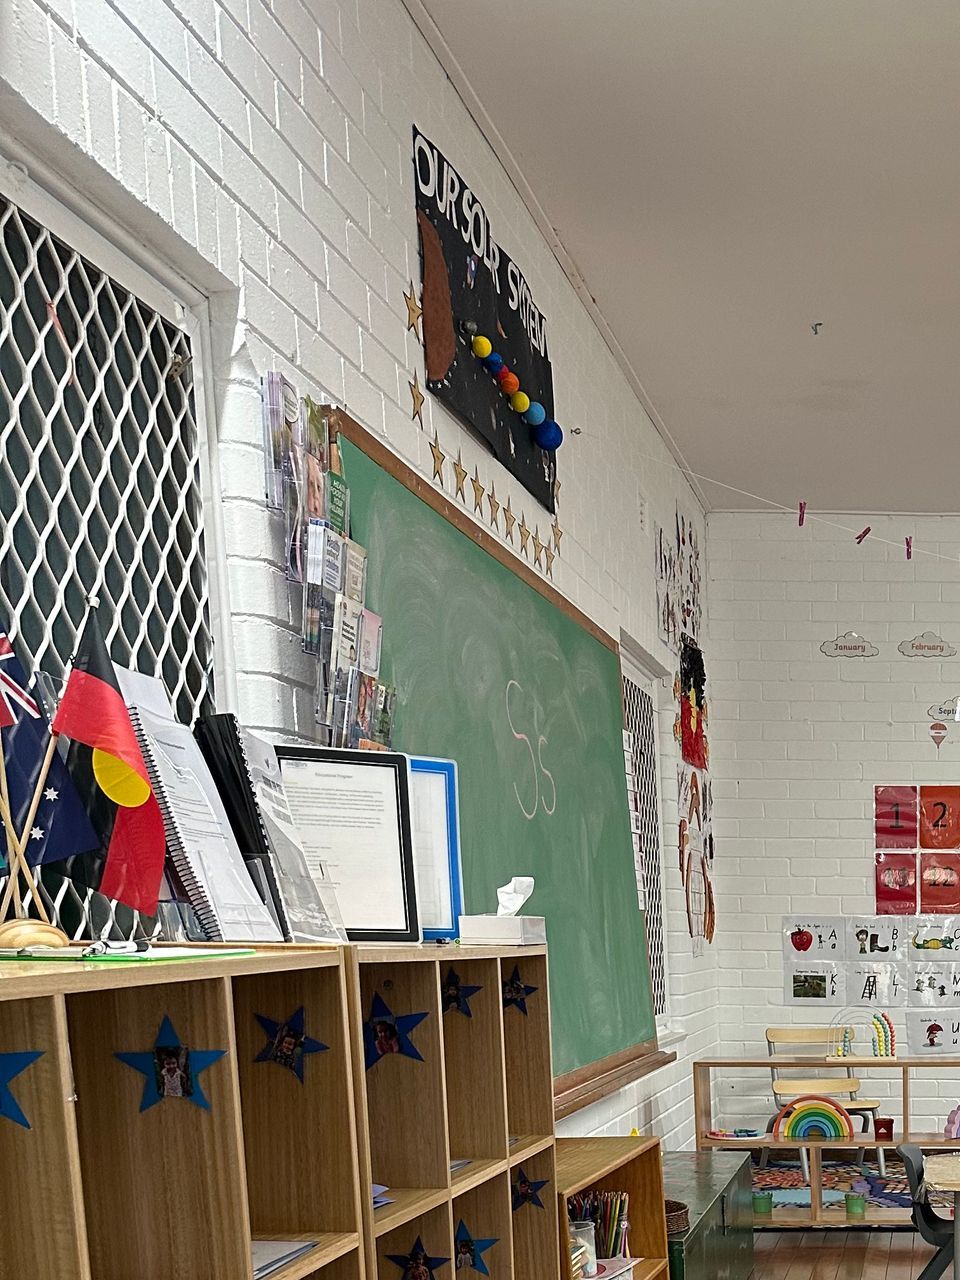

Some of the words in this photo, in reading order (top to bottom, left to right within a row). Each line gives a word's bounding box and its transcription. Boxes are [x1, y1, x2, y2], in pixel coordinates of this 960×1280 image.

[414, 134, 458, 230] OUR
[461, 188, 500, 294] SOLR
[834, 643, 866, 653] January
[911, 642, 944, 653] February
[889, 802, 905, 829] 1
[932, 801, 948, 828] 2
[828, 929, 837, 940] A
[892, 929, 898, 940] B
[953, 928, 960, 940] C
[830, 974, 838, 985] K
[952, 1022, 960, 1033] U
